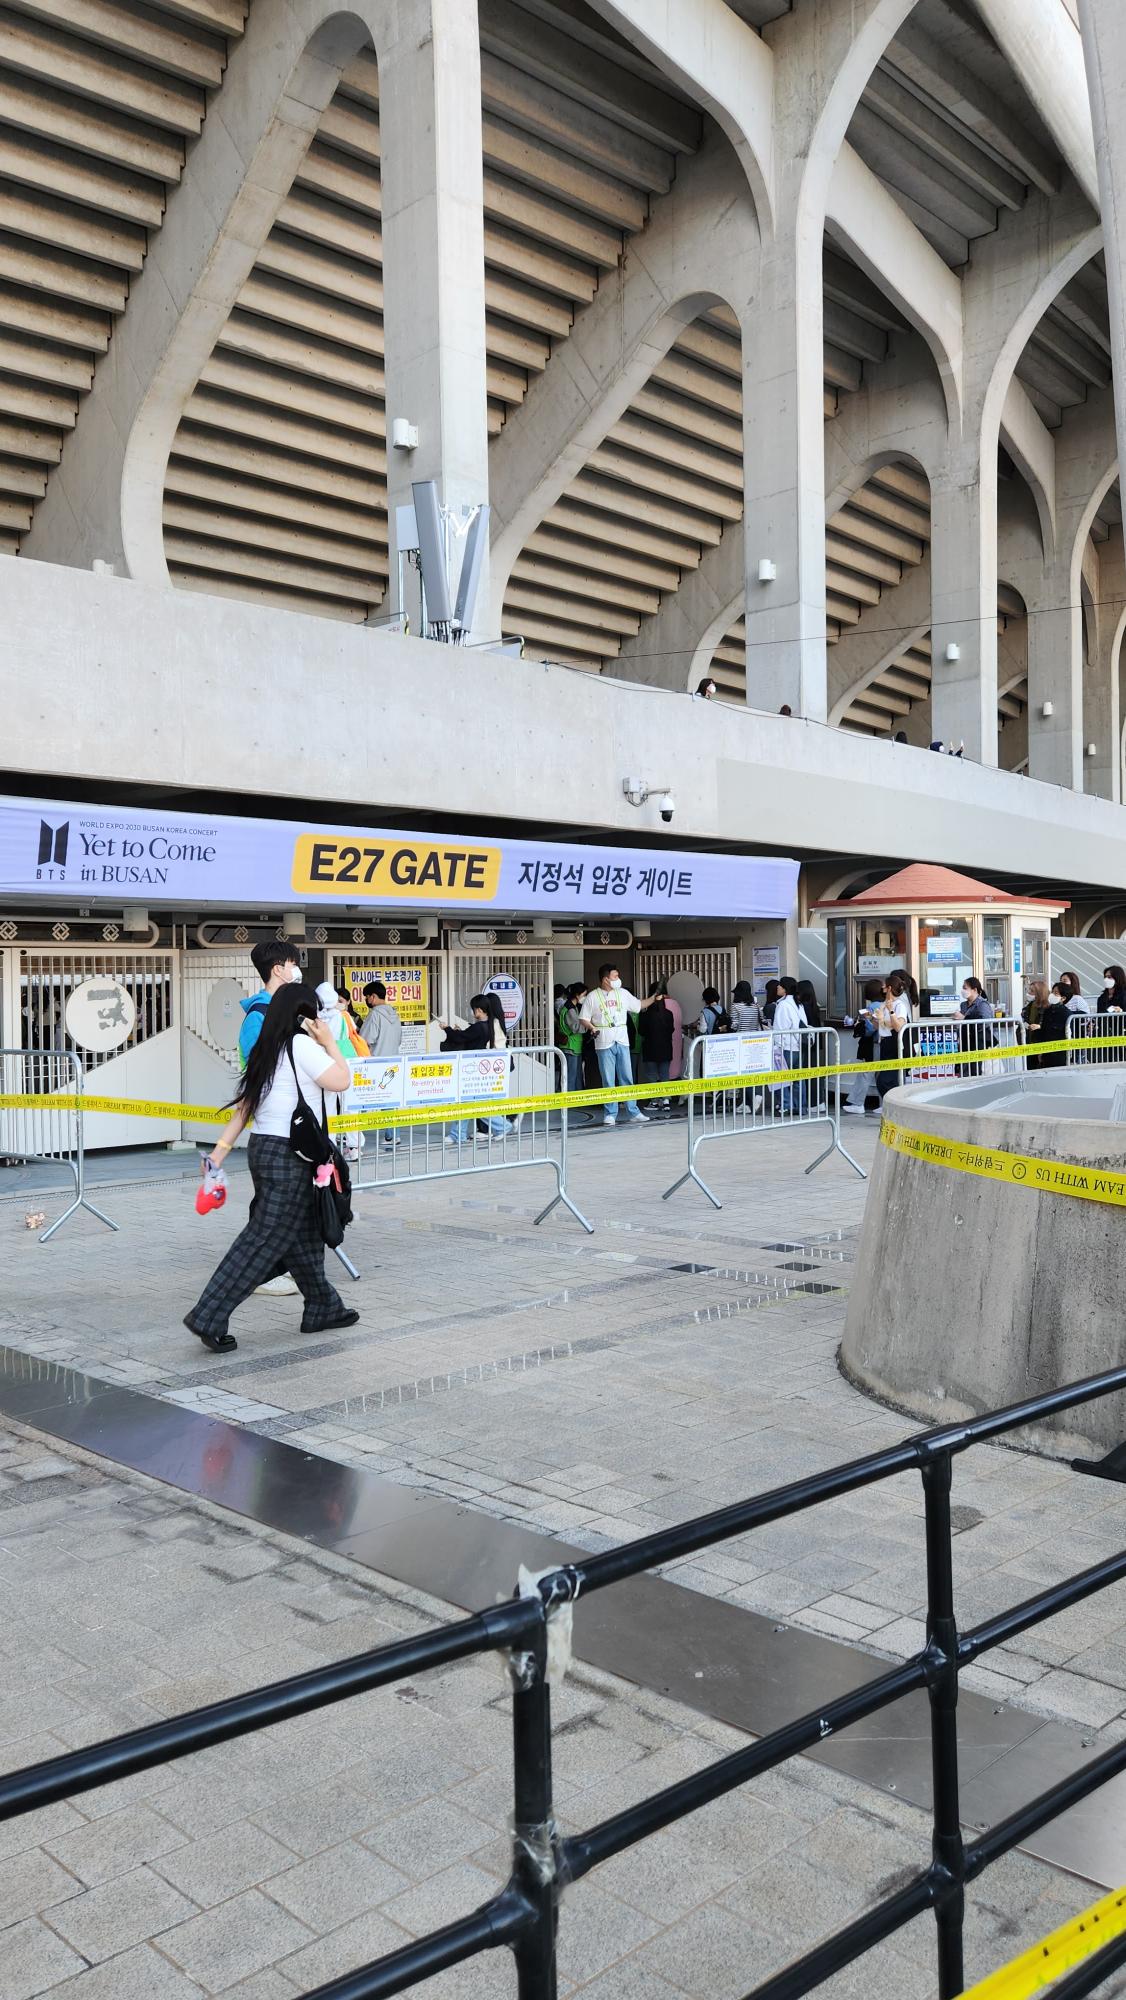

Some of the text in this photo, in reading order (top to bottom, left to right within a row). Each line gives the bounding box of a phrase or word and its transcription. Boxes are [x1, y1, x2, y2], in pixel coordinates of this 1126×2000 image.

[79, 820, 218, 836] WORLD EXPO 2030 BUSAN KOREA CONCERT
[79, 833, 216, 862] Yet to Come
[309, 843, 488, 888] E27 GATE
[36, 868, 66, 881] BTS
[81, 864, 168, 884] in BUSAN
[518, 860, 692, 898] 지정석 입장 게이트
[352, 970, 421, 982] 아시아드 보조경기장
[401, 985, 421, 1001] 안내
[421, 1066, 435, 1077] 입장
[438, 1064, 452, 1076] 불가
[178, 1108, 198, 1118] DREAM
[905, 1135, 921, 1151] WITH
[922, 1141, 953, 1160] DREAM
[958, 1151, 1005, 1172] 드림위더스
[1036, 1167, 1051, 1182] US
[1054, 1171, 1089, 1189] WITH
[1094, 1179, 1126, 1196] EAM
